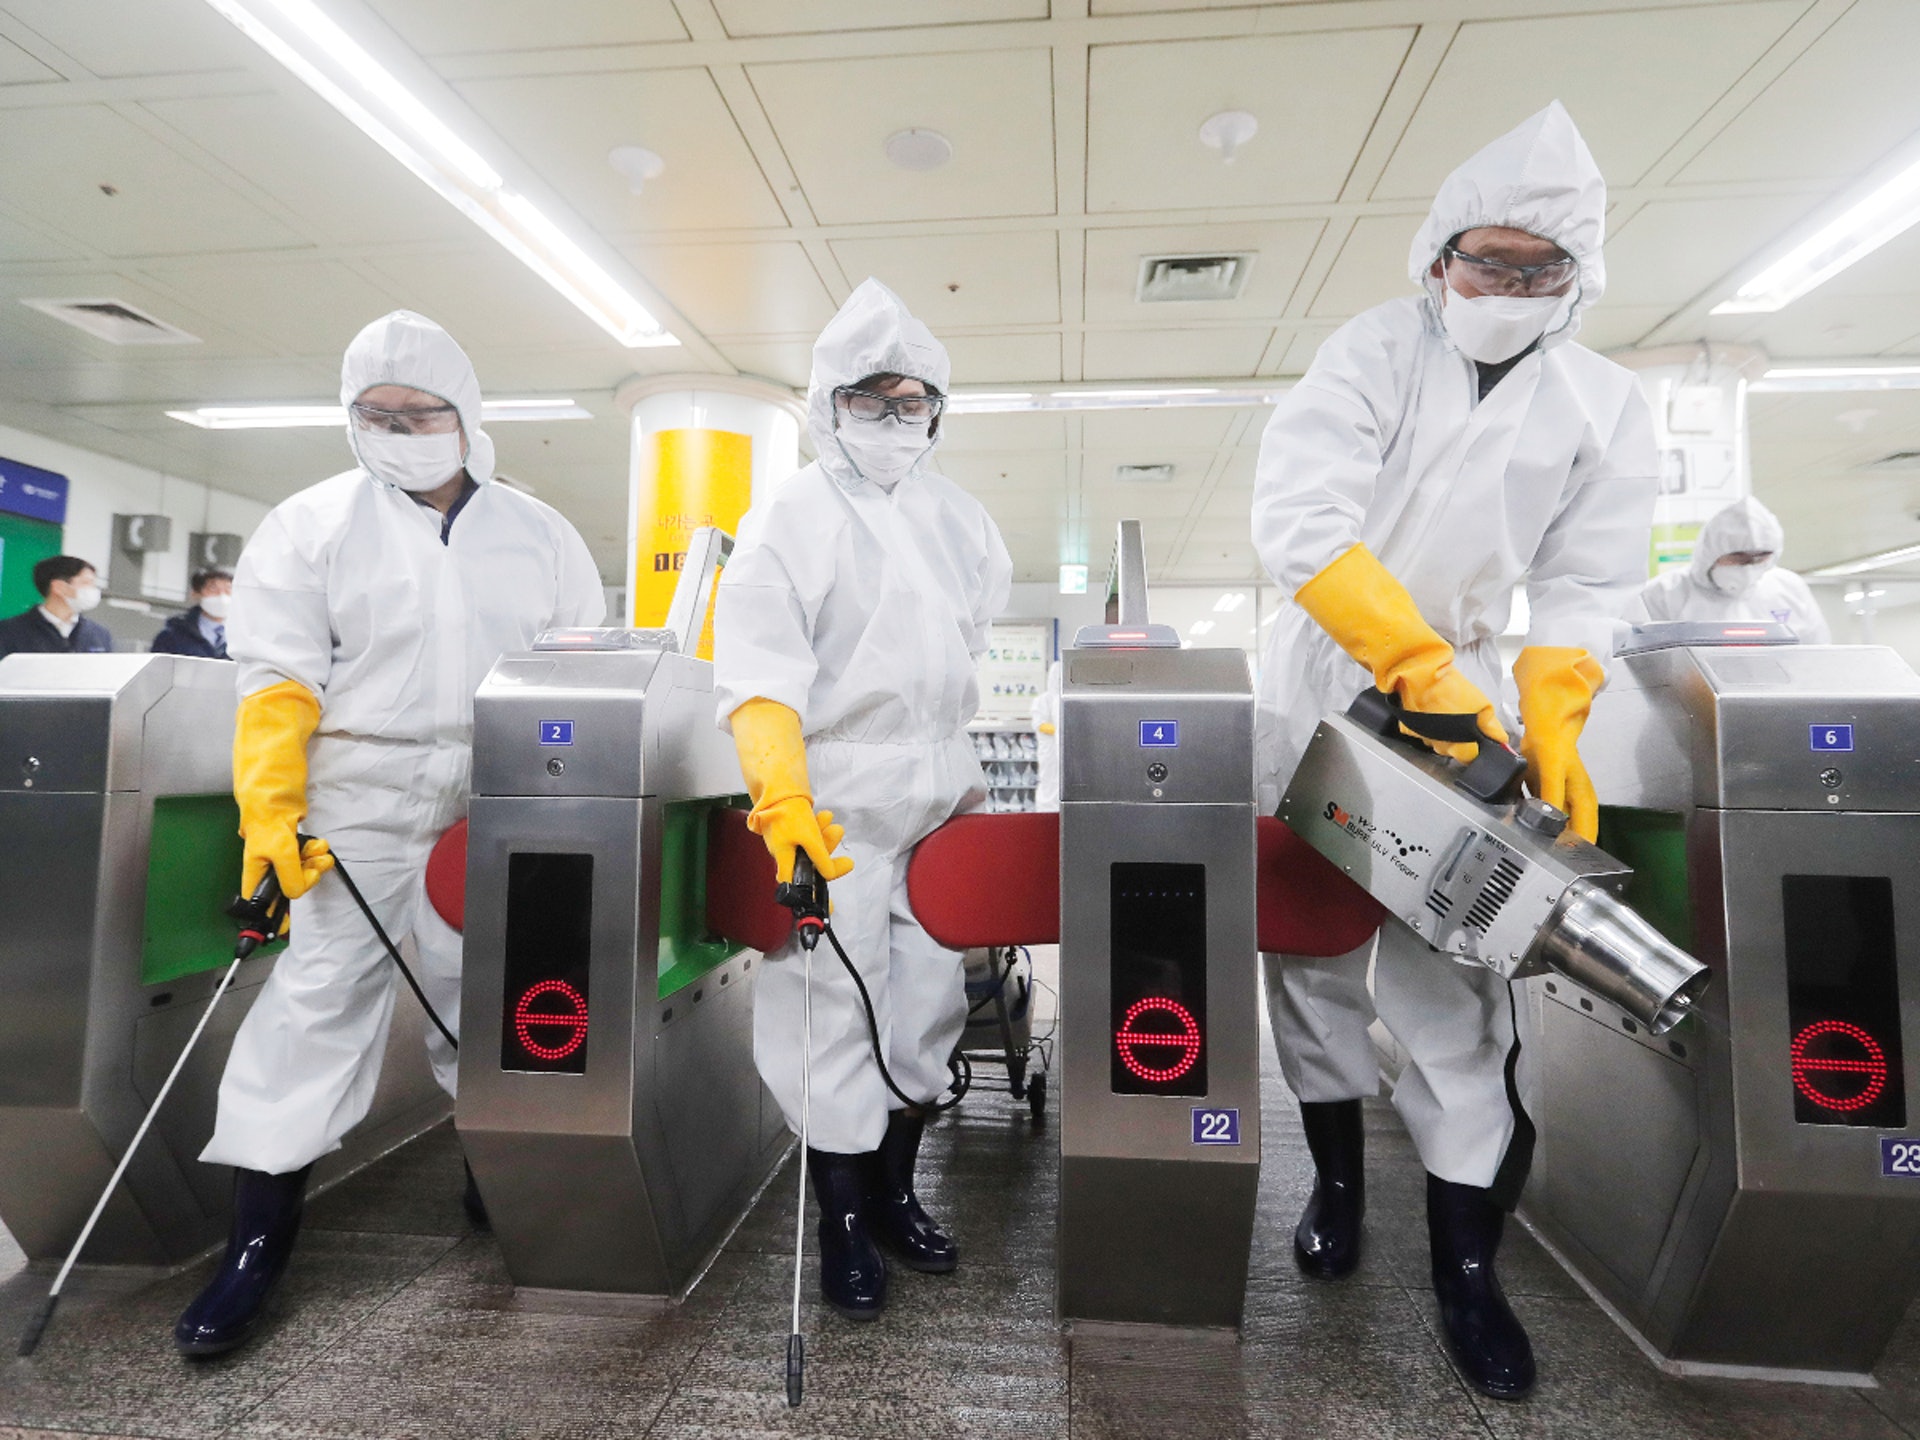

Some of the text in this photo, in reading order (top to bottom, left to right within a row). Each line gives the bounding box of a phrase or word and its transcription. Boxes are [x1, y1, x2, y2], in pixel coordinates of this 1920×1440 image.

[658, 513, 697, 531] 나가는
[551, 725, 561, 739] 2
[1153, 726, 1164, 740] 4
[1825, 730, 1838, 745] 6
[1201, 1113, 1231, 1140] 22
[1891, 1143, 1920, 1173] 23
